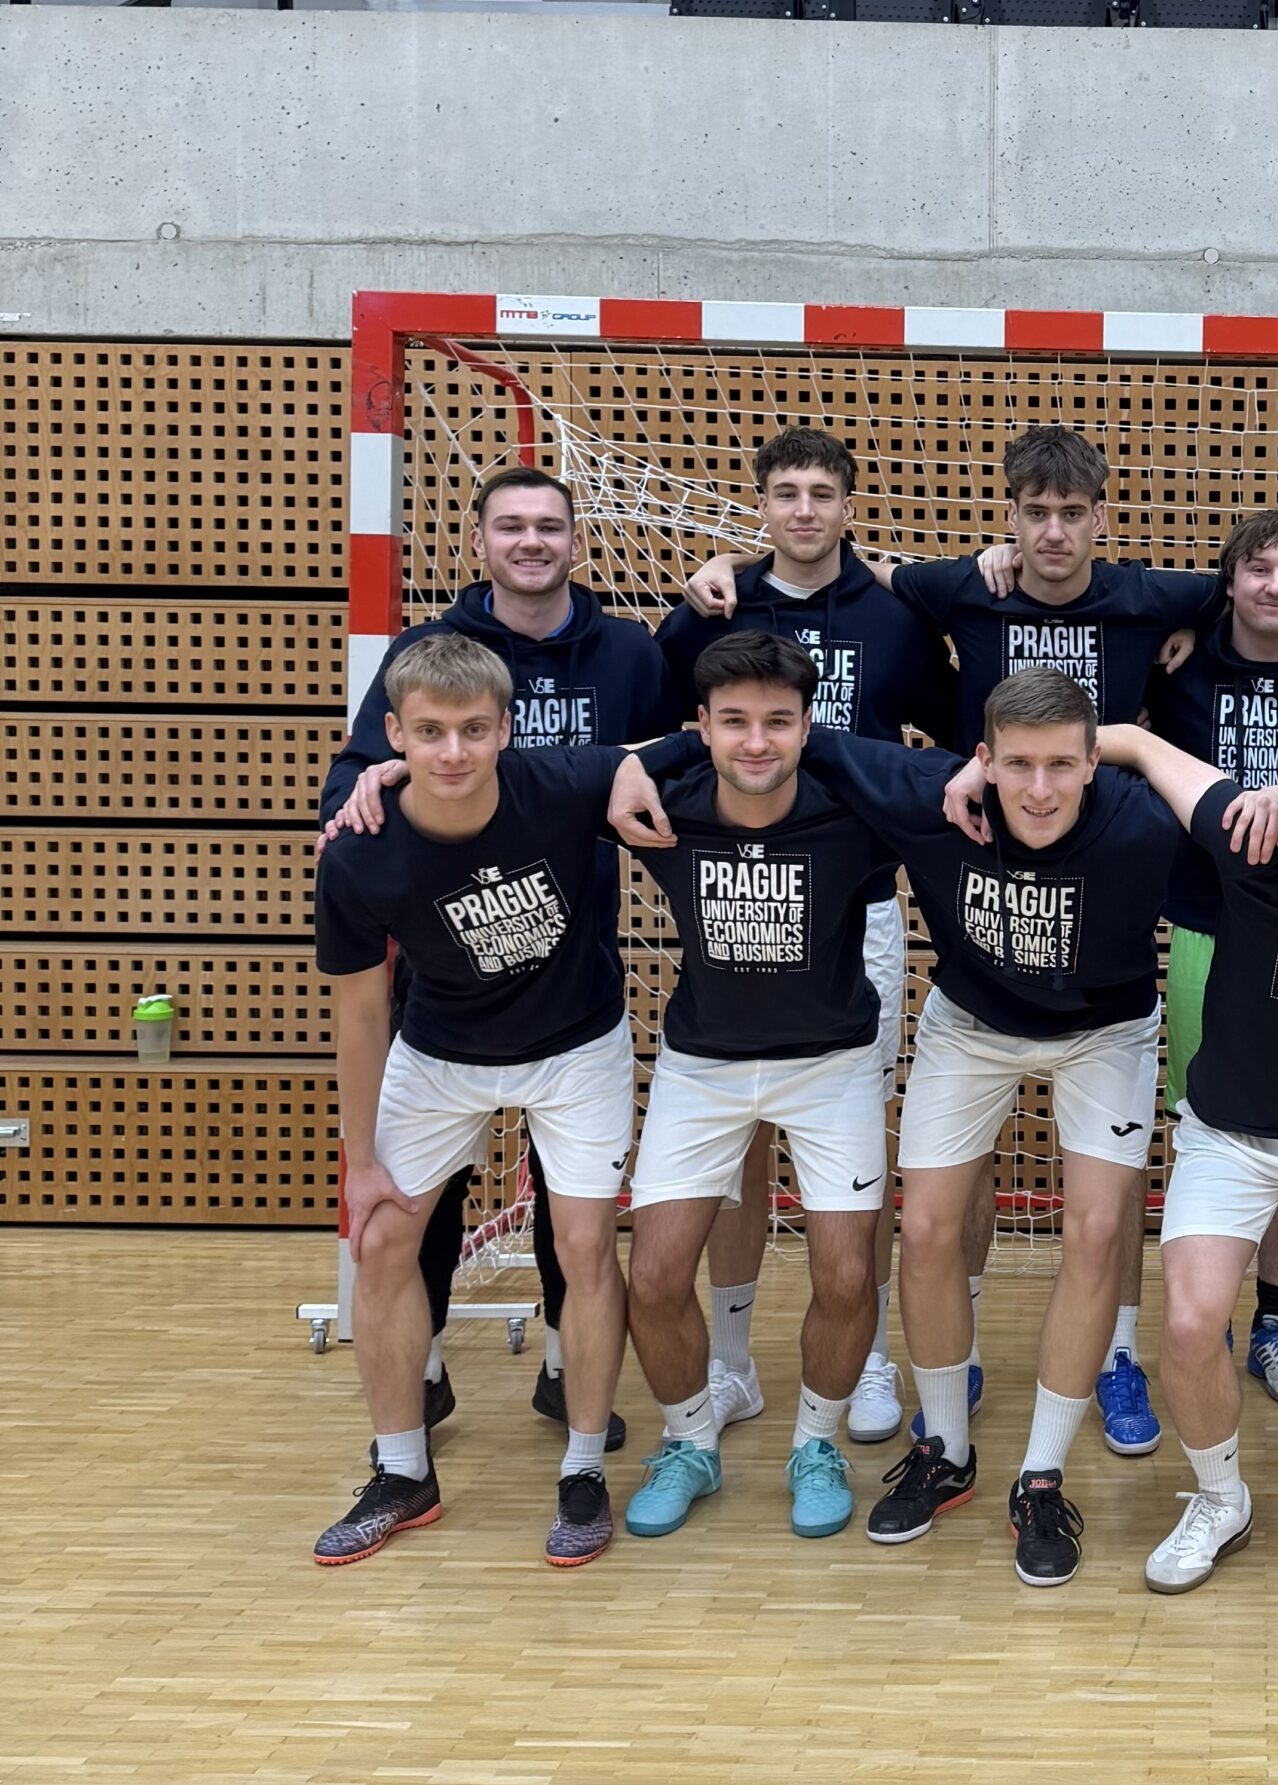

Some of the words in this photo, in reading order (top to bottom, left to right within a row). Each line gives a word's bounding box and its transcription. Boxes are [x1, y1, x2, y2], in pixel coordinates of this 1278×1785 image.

[500, 310, 538, 319] MTB
[552, 313, 596, 321] GROUP
[1008, 624, 1098, 658] PRAGUE
[1085, 662, 1098, 678] OF
[840, 685, 854, 701] OF
[513, 698, 592, 734] RAGUE
[700, 859, 804, 901] PRAGUE
[445, 871, 556, 931] PRAGUE
[964, 872, 1076, 920] PRAGUE
[459, 908, 544, 945] UNIVERSITY
[544, 901, 560, 917] OF
[700, 899, 788, 923] UNIVERSITY
[789, 906, 804, 924] OF
[964, 904, 1055, 937] UNIVRSITY
[470, 914, 567, 956] ECONOMICS
[702, 919, 804, 944] ECONOMICS
[478, 955, 504, 972] AND
[707, 941, 730, 959] AND
[733, 944, 804, 962] BUSINESS
[994, 946, 1069, 968] BSINESS
